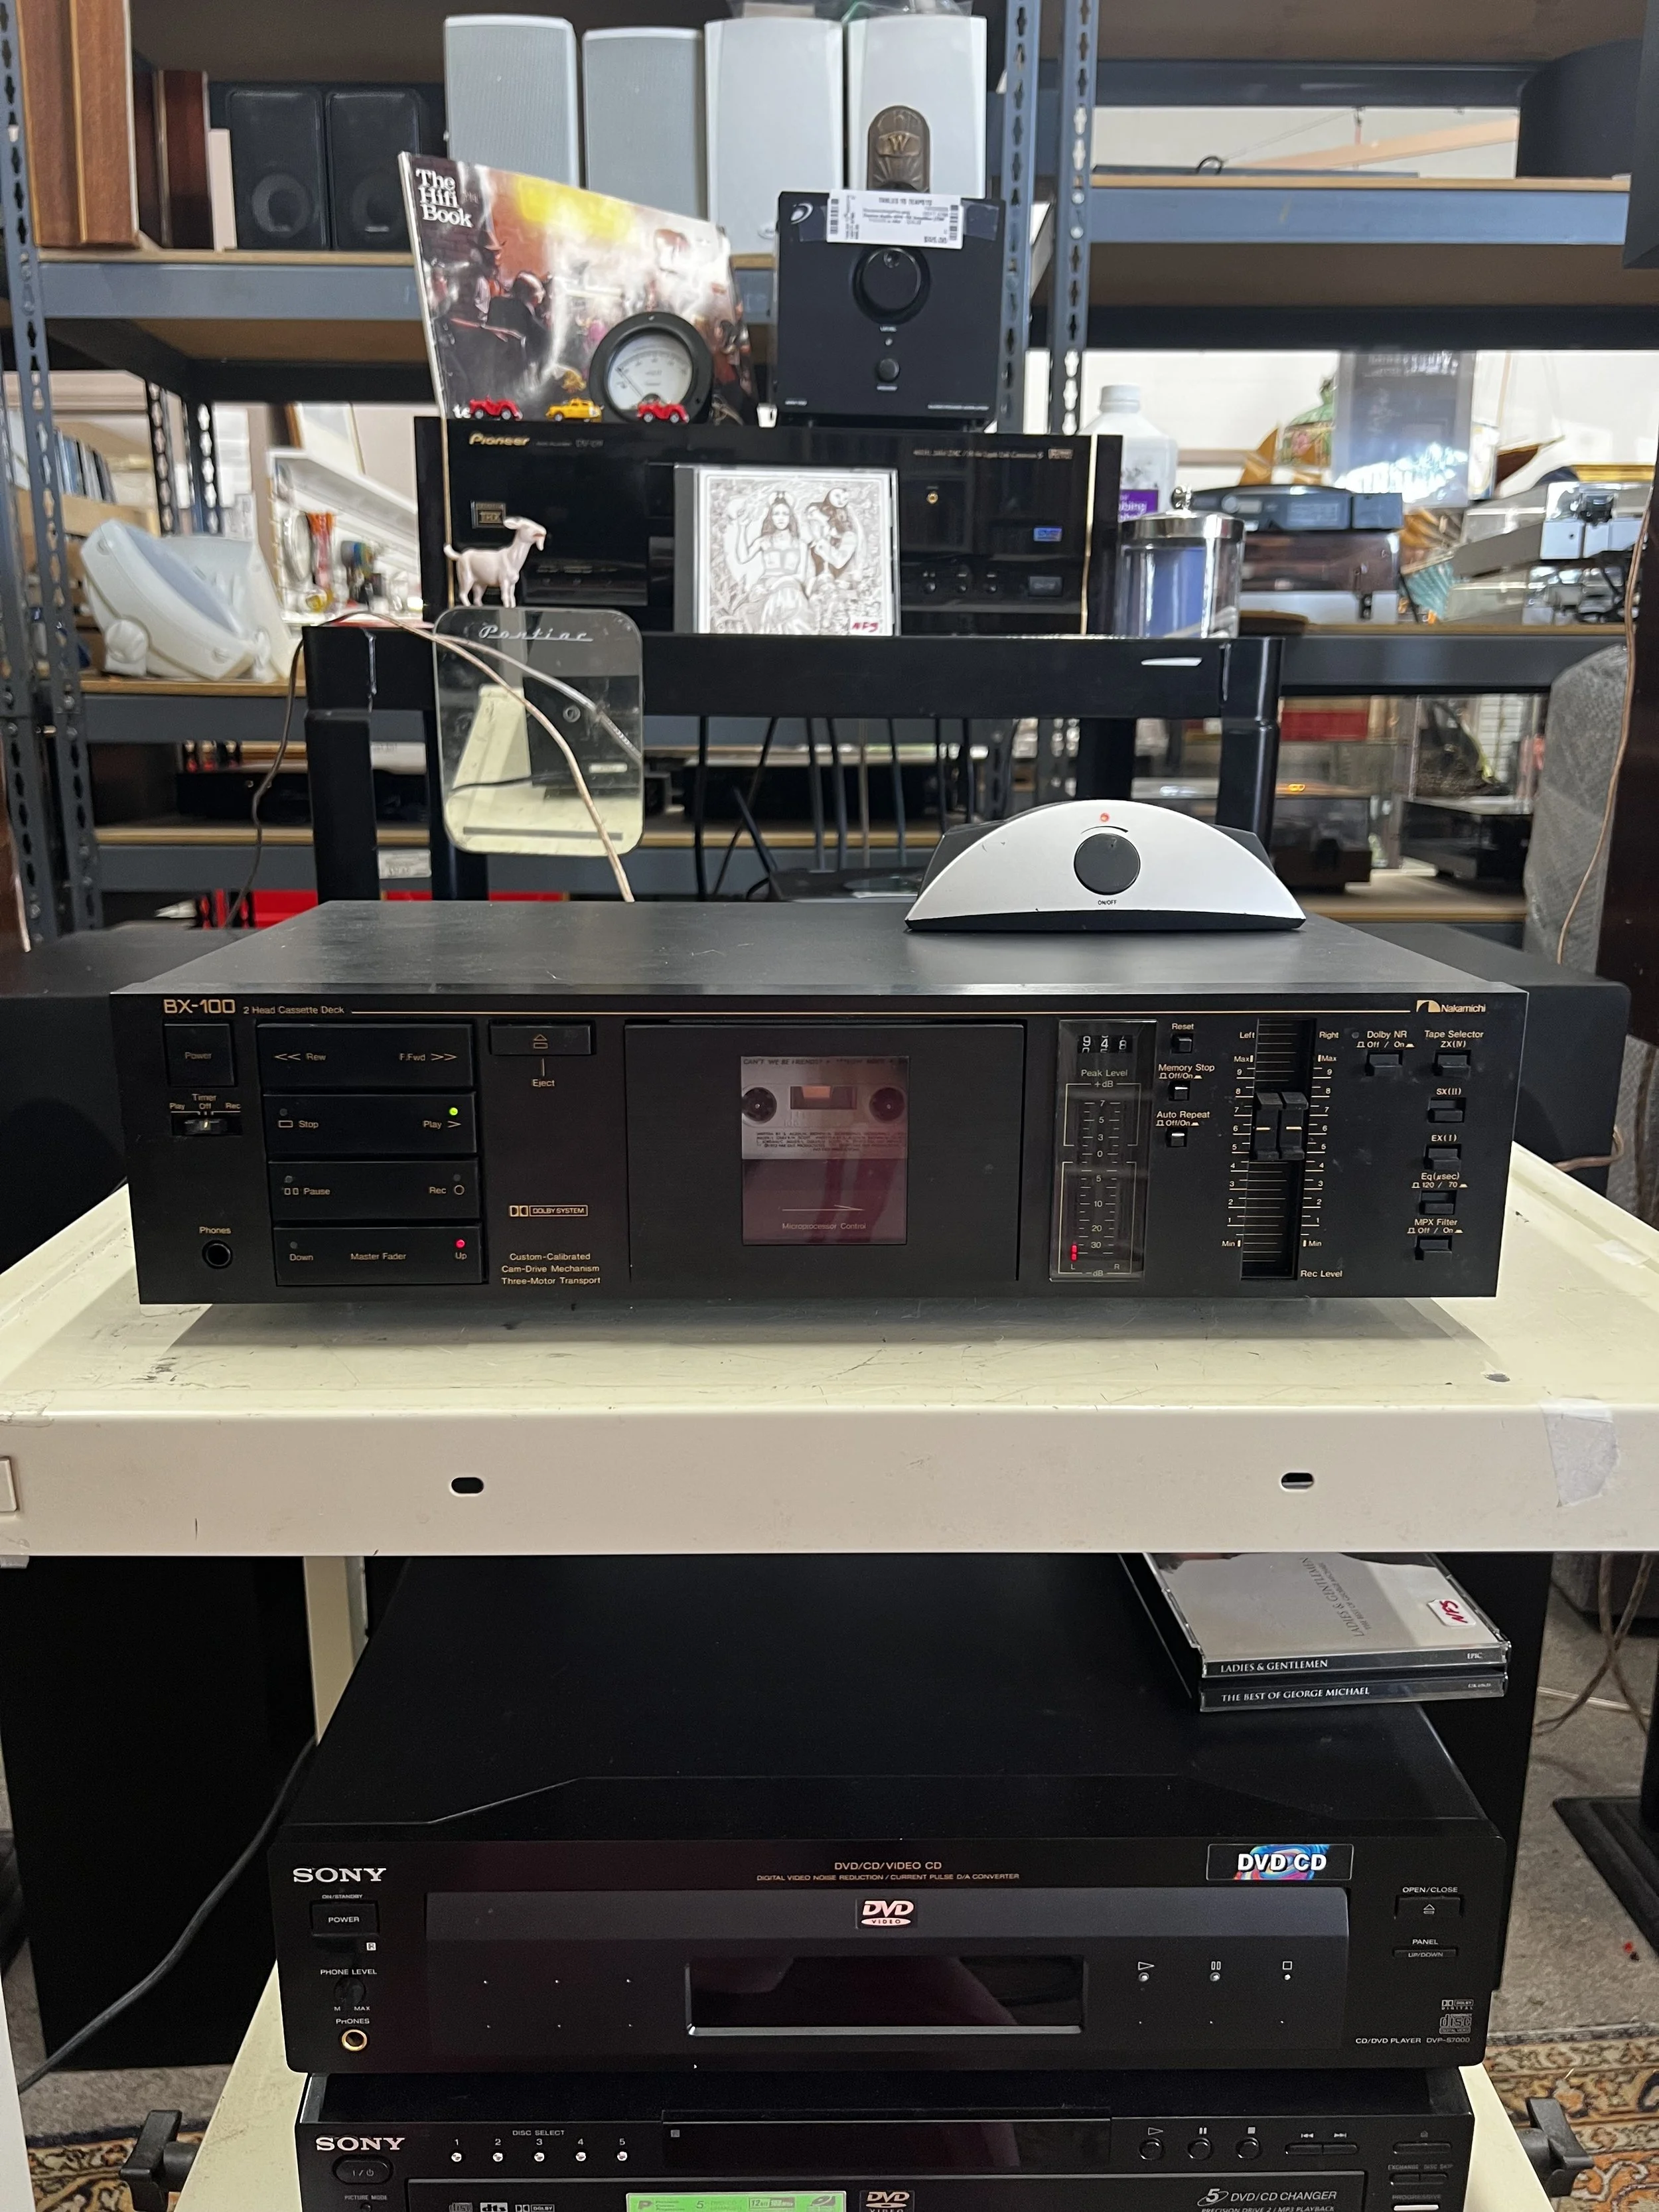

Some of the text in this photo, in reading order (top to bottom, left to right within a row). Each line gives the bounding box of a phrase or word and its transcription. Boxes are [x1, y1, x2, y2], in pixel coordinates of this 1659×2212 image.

[415, 169, 456, 190] The
[418, 187, 459, 208] Hifi
[420, 203, 473, 228] Book
[469, 432, 530, 446] Pioneer
[478, 625, 594, 642] Pontiac
[163, 999, 236, 1013] BX-100
[321, 1005, 345, 1014] Deck
[1441, 1004, 1486, 1013] Nakamichi
[1319, 1031, 1339, 1040] Right
[1367, 1031, 1391, 1039] Dolby
[1425, 1030, 1484, 1039] Tape Selector
[399, 1053, 426, 1061] F.Fwd
[1158, 1063, 1215, 1072] Memory Stop
[532, 1078, 555, 1088] Eject
[169, 1102, 186, 1111] Play
[1179, 1111, 1210, 1120] Repeat
[299, 1120, 319, 1129] Stop
[423, 1120, 443, 1129] Play
[289, 1253, 314, 1262] Down
[455, 1252, 467, 1260] Up
[501, 1265, 547, 1274] Cam-Drive
[501, 1276, 601, 1286] Three-Motor Transport
[1220, 1659, 1328, 1673] LADIES & GENTLEMEN
[1244, 1692, 1265, 1701] BEST
[1283, 1689, 1323, 1698] GEORGE
[1325, 1686, 1370, 1696] MICHAEL
[834, 1862, 921, 1870] DVD/CD/VIDEO
[1237, 1853, 1328, 1872] DVD CD
[293, 1868, 386, 1882] SONY
[862, 1900, 914, 1916] DVD
[315, 2137, 405, 2151] SONY
[867, 2191, 910, 2201] DVD
[1205, 2188, 1337, 2202] 5 DVD/CD CHANGER
